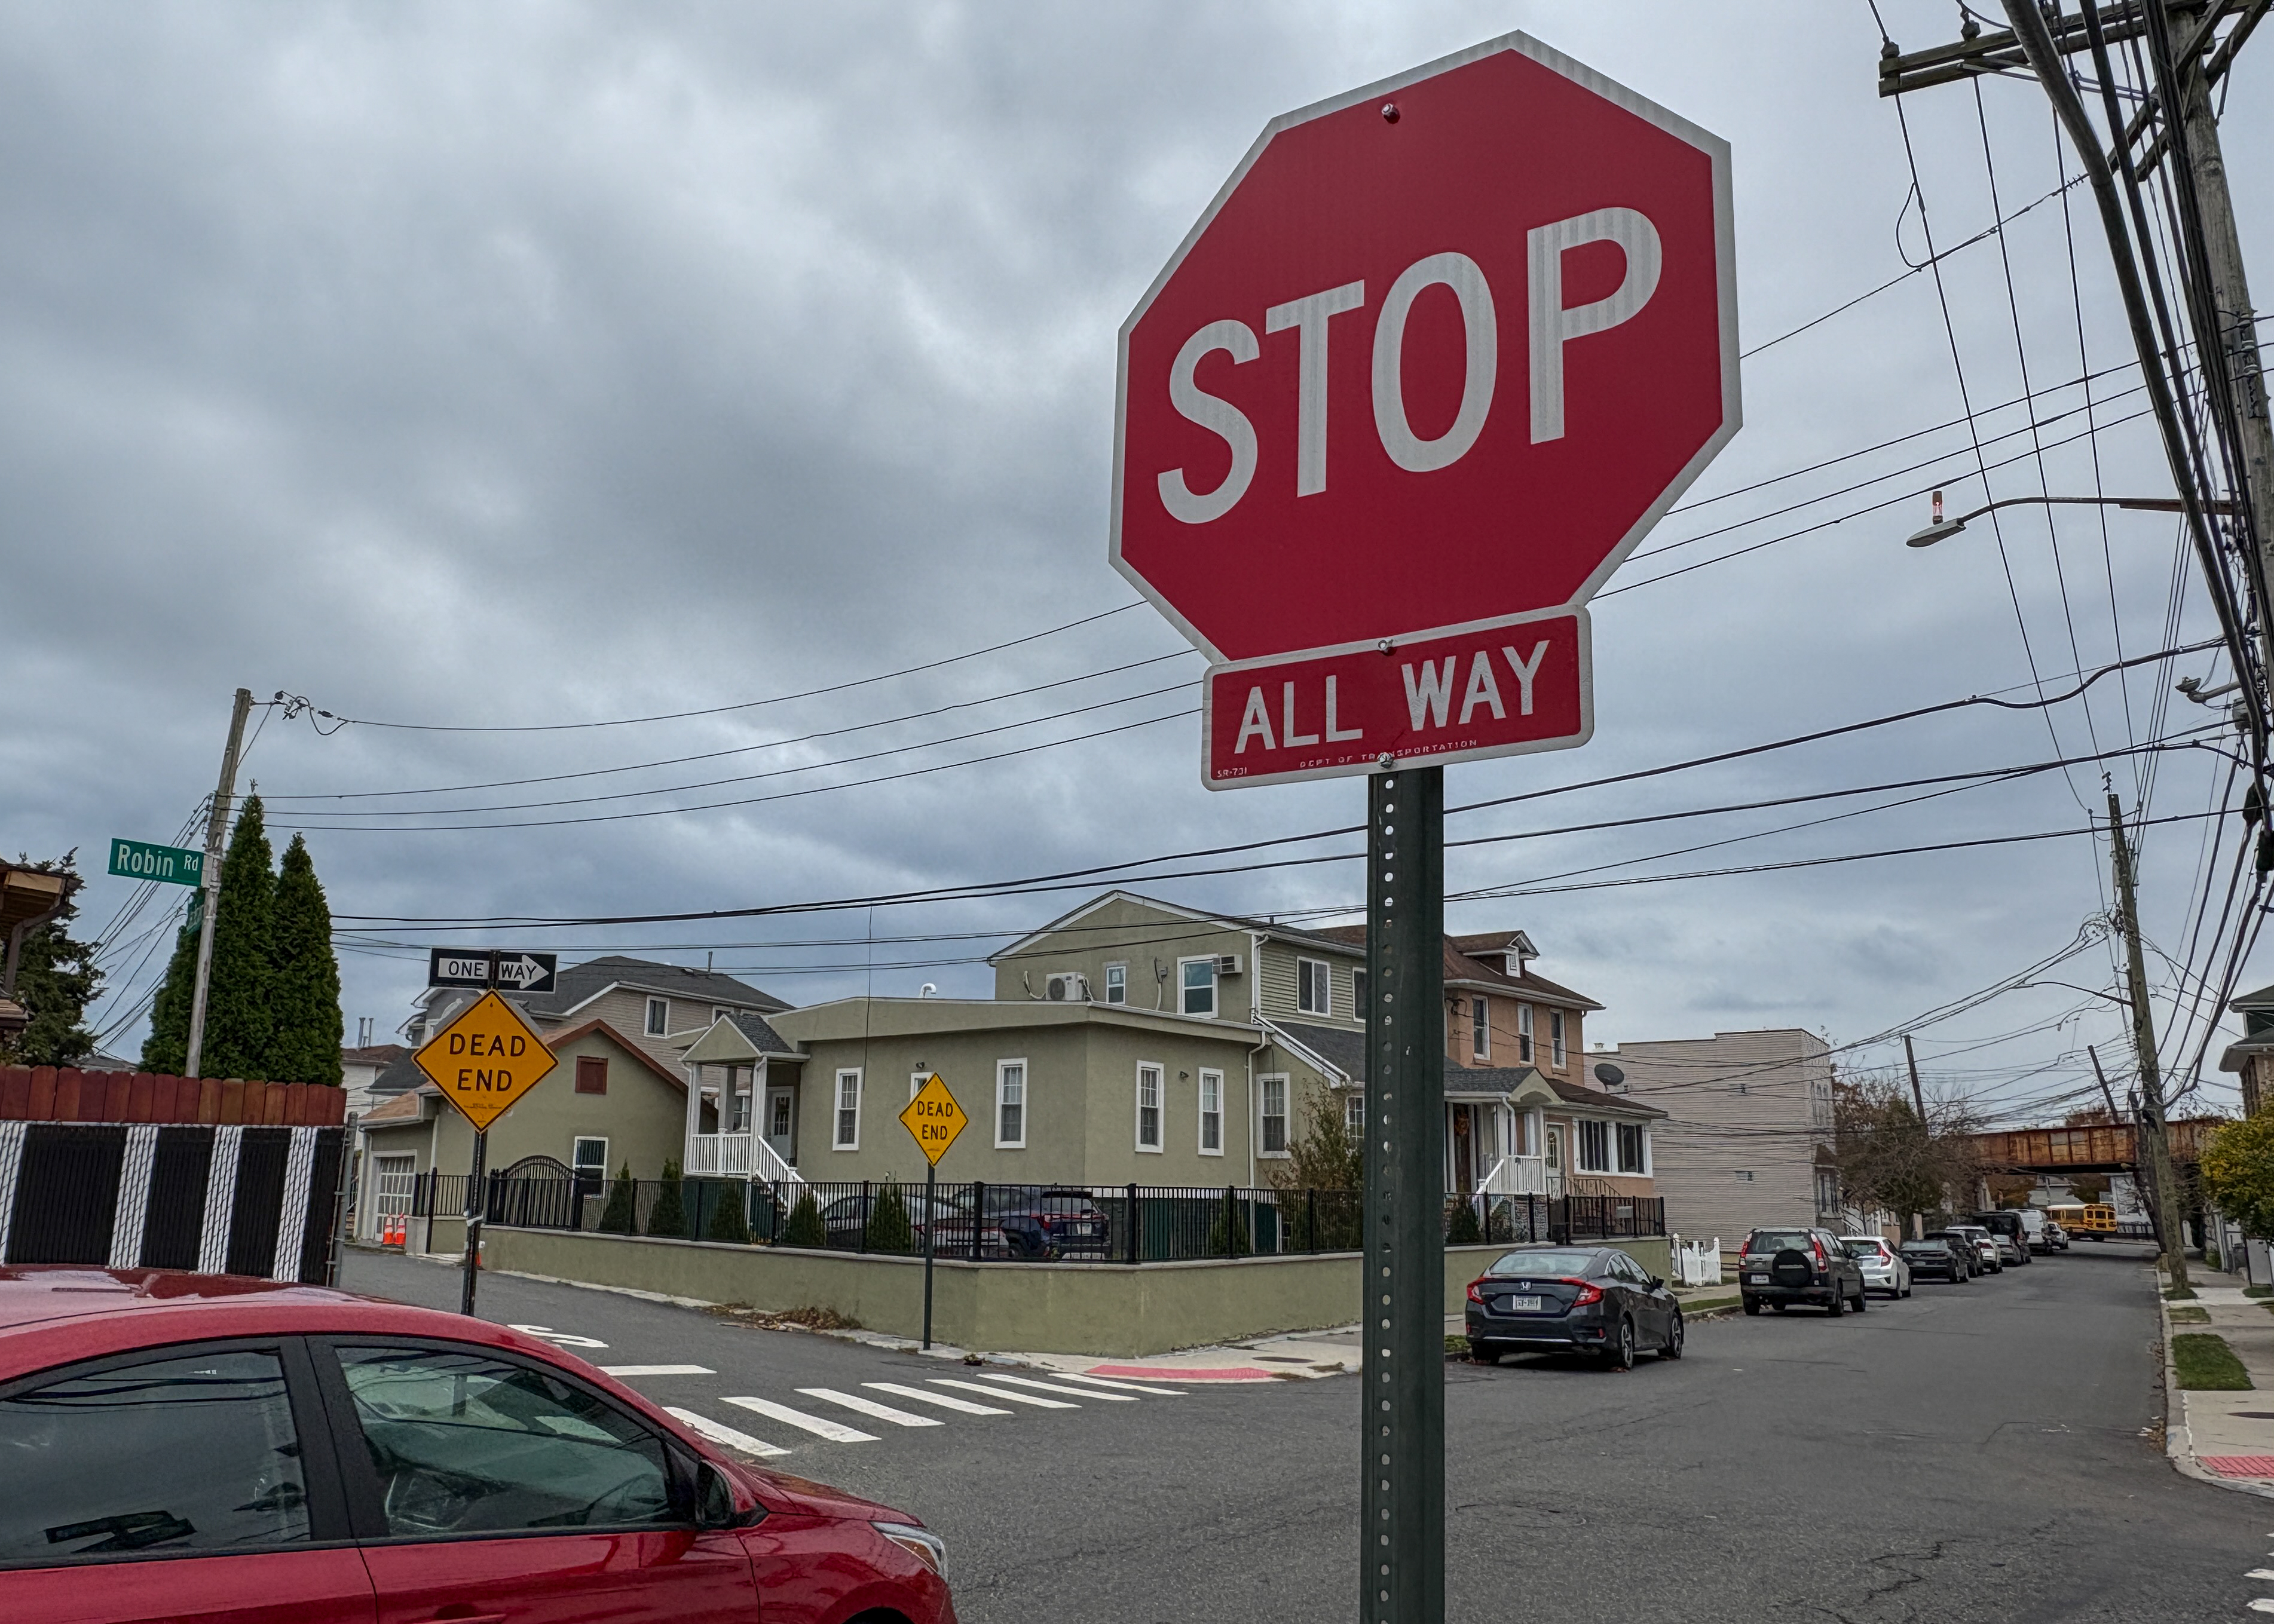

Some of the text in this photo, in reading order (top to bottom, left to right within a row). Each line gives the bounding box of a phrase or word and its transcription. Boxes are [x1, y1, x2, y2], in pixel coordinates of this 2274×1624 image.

[1158, 207, 1662, 523] STOP
[1234, 640, 1550, 754] ALL WAY
[1299, 758, 1330, 768] DEPT
[117, 844, 199, 877] Robin Rd
[448, 961, 537, 980] ONE WAY
[449, 1033, 526, 1057] DEAD
[457, 1069, 512, 1092] END
[917, 1101, 953, 1117] DEAD
[922, 1124, 948, 1140] END
